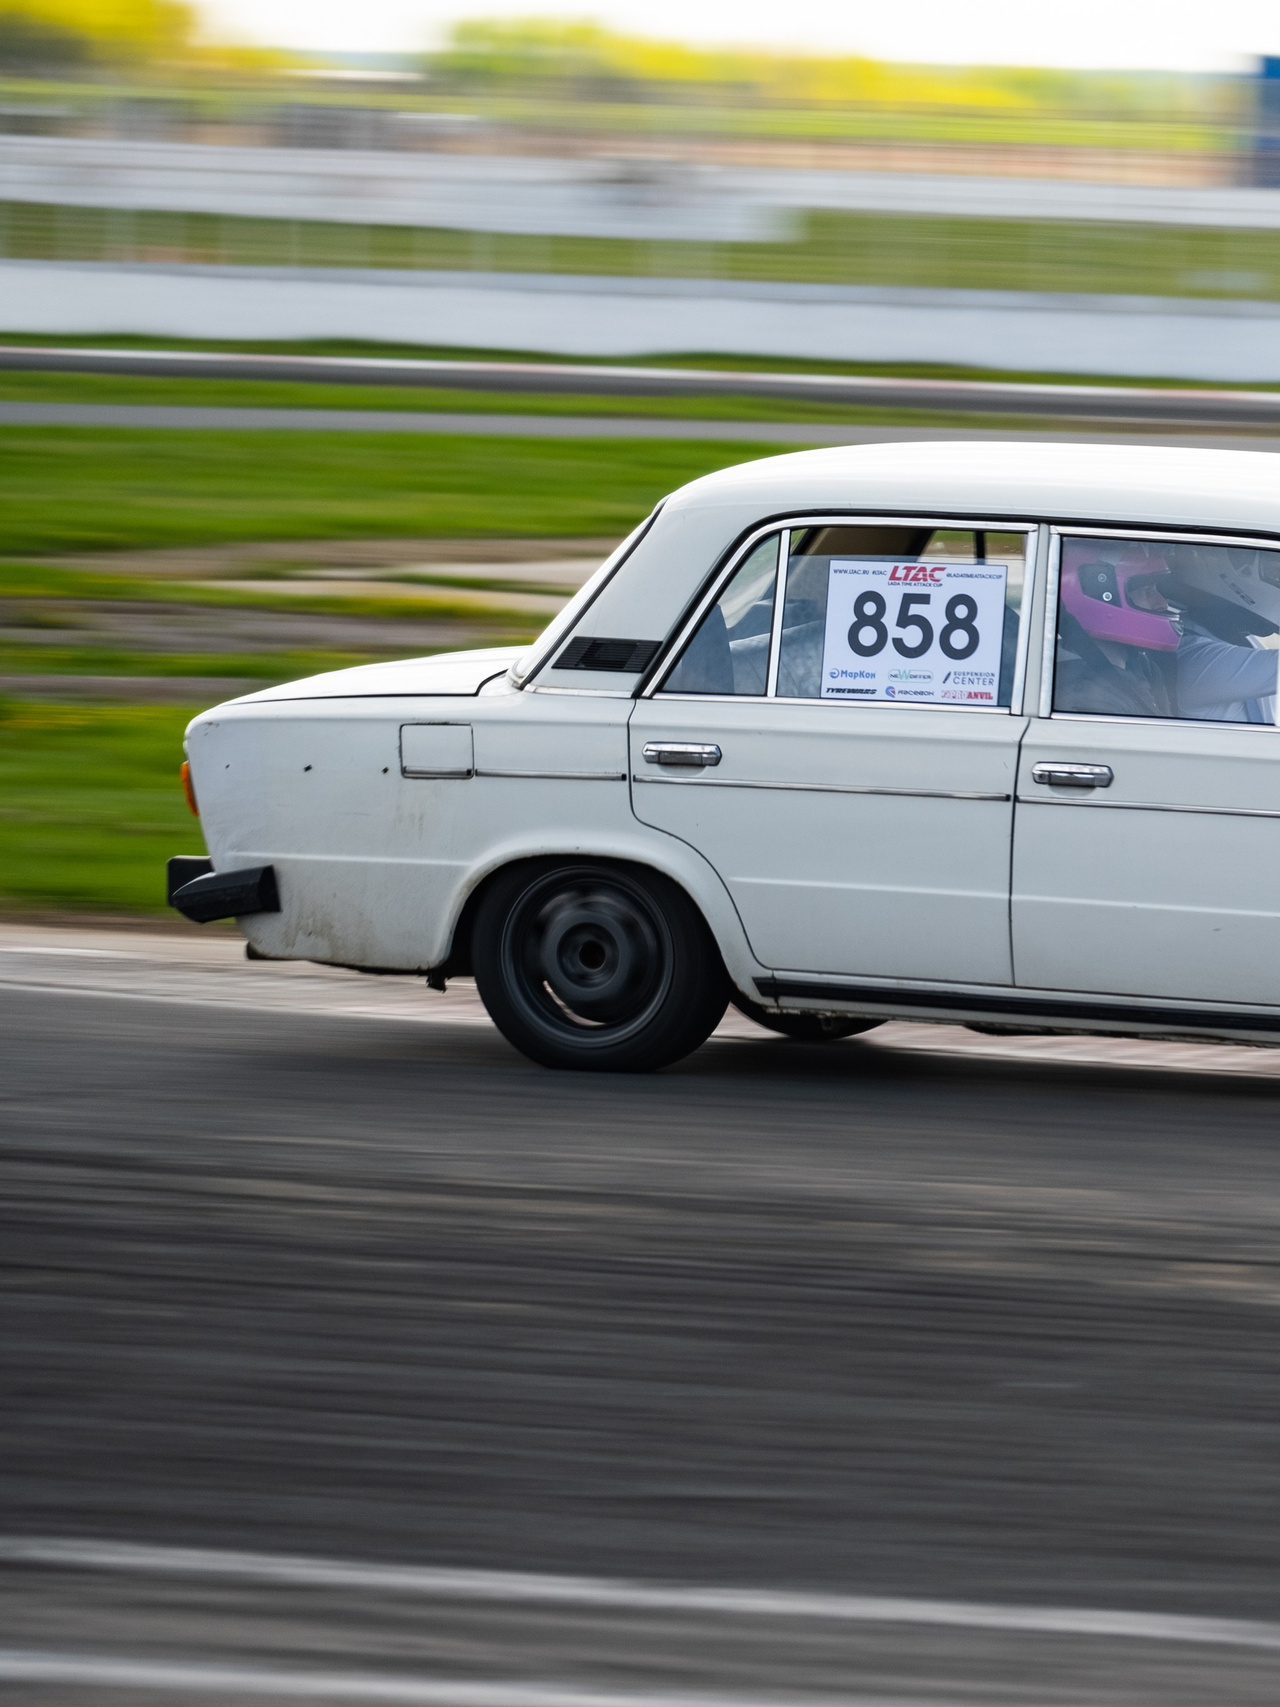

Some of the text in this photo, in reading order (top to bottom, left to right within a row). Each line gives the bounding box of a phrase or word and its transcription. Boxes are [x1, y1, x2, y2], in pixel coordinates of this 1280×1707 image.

[889, 565, 947, 582] LTAC
[847, 590, 980, 661] 858
[953, 677, 994, 686] CENTER
